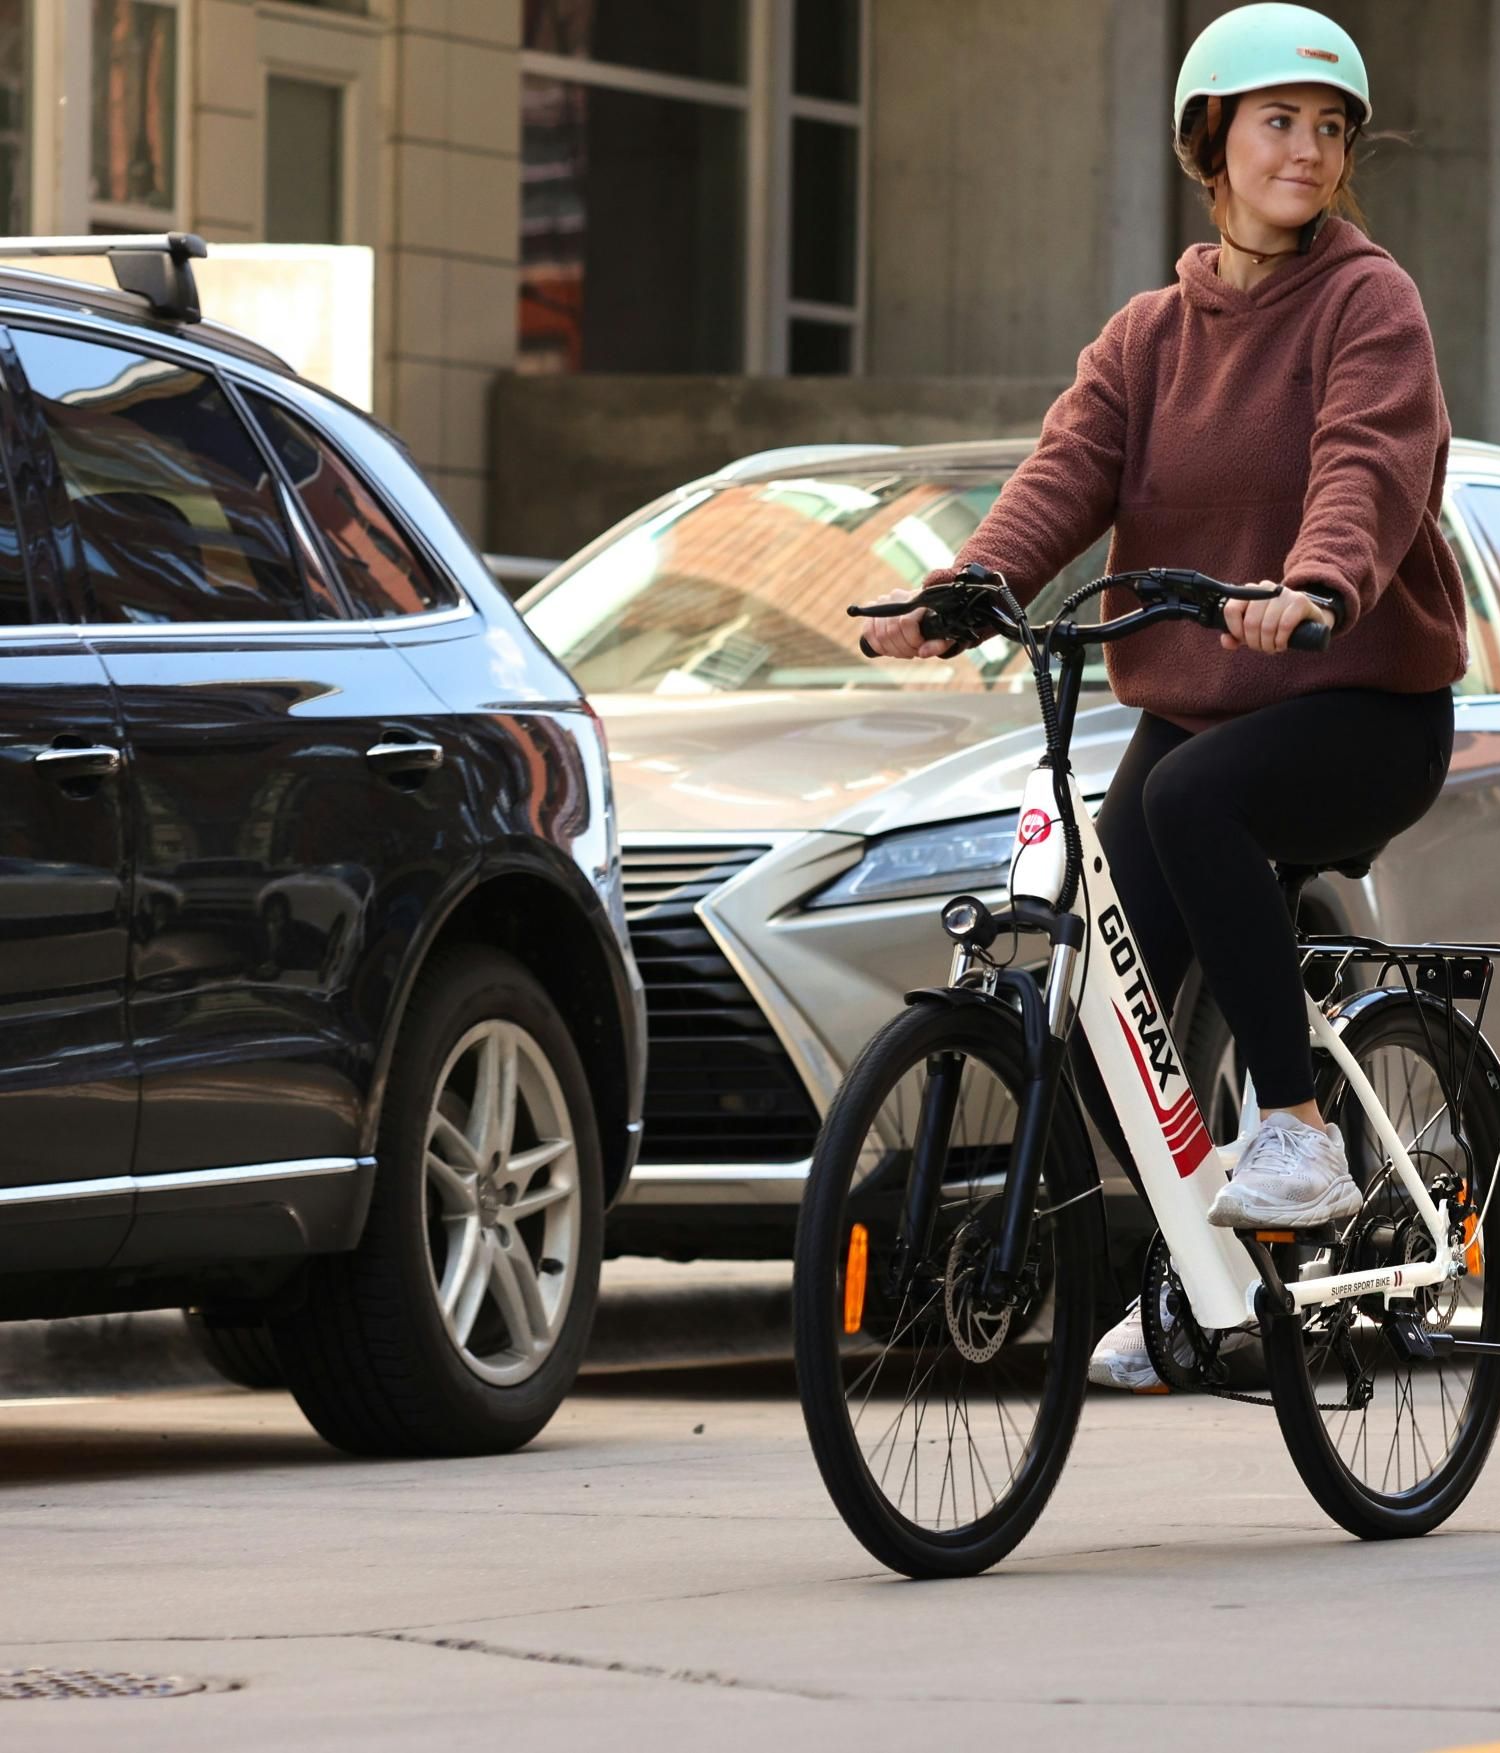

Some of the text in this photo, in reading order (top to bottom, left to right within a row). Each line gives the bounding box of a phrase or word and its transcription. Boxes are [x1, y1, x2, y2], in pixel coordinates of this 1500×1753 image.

[1098, 904, 1180, 1093] GOTRAX
[1331, 1276, 1391, 1296] SUPER SPORT BIKE
